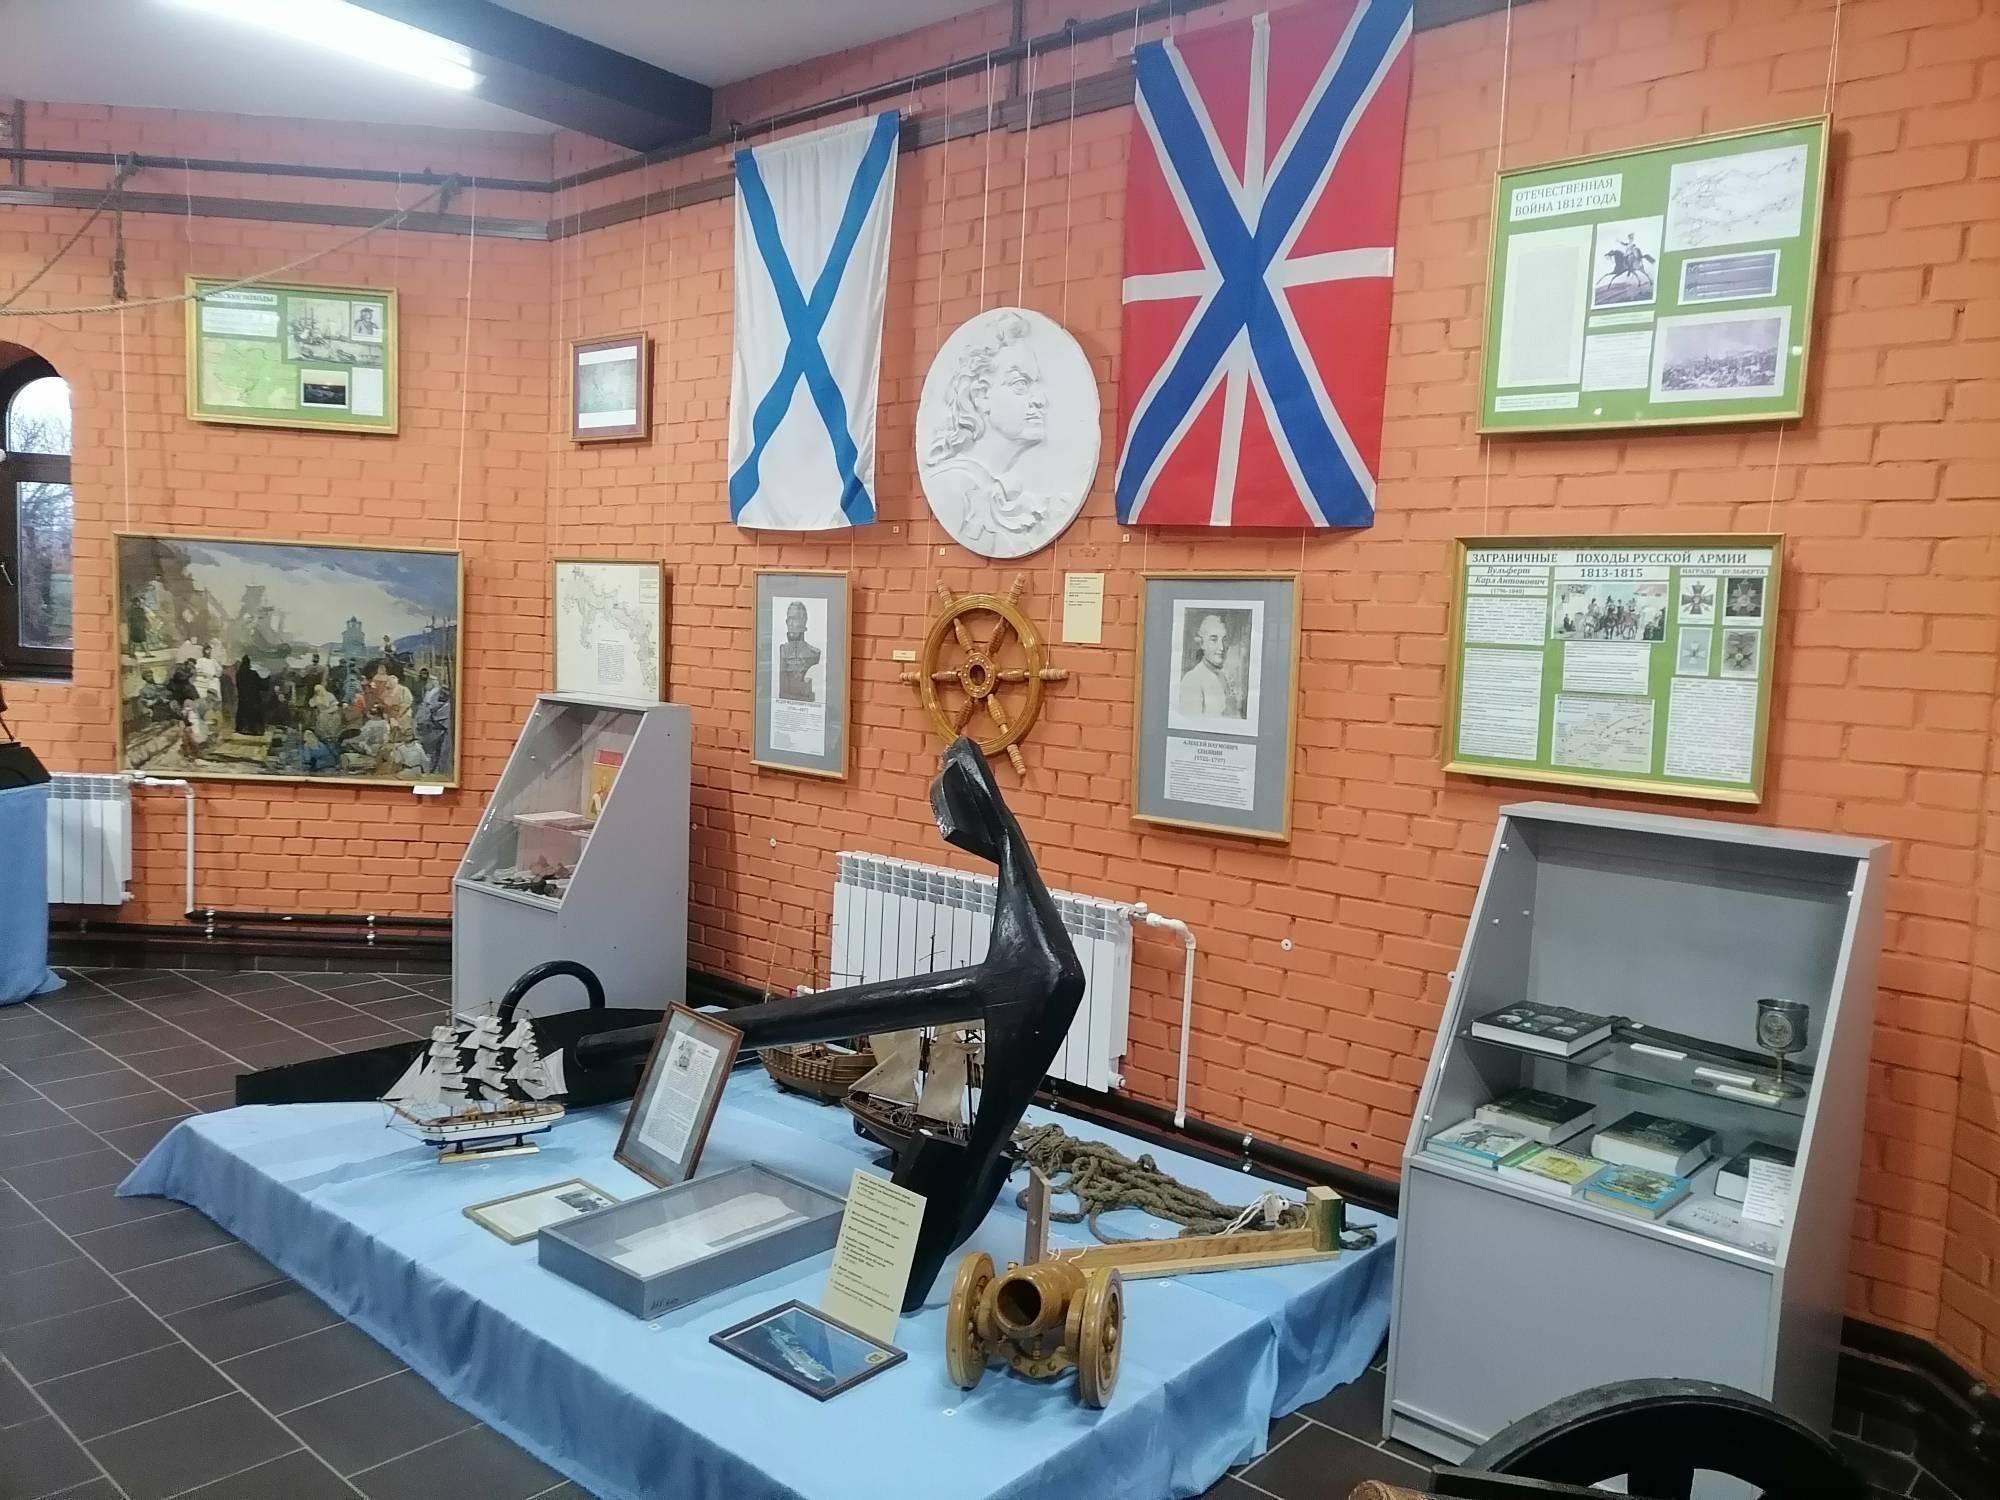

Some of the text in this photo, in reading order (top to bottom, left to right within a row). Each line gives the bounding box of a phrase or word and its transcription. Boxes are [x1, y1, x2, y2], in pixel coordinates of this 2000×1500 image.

[1516, 178, 1613, 201] ОТЕЧЕСТВЕННАЯ
[1515, 193, 1617, 216] ВОЙНА 1812 ГОДА
[1472, 551, 1747, 564] ЗАГРАНИЧНЫЕ ПОХОДЫ РУССКОЙ АРМИИ
[1487, 566, 1530, 577] Вульферт
[1580, 568, 1643, 578] 1813-1815
[1475, 577, 1545, 586] Карл Антонович
